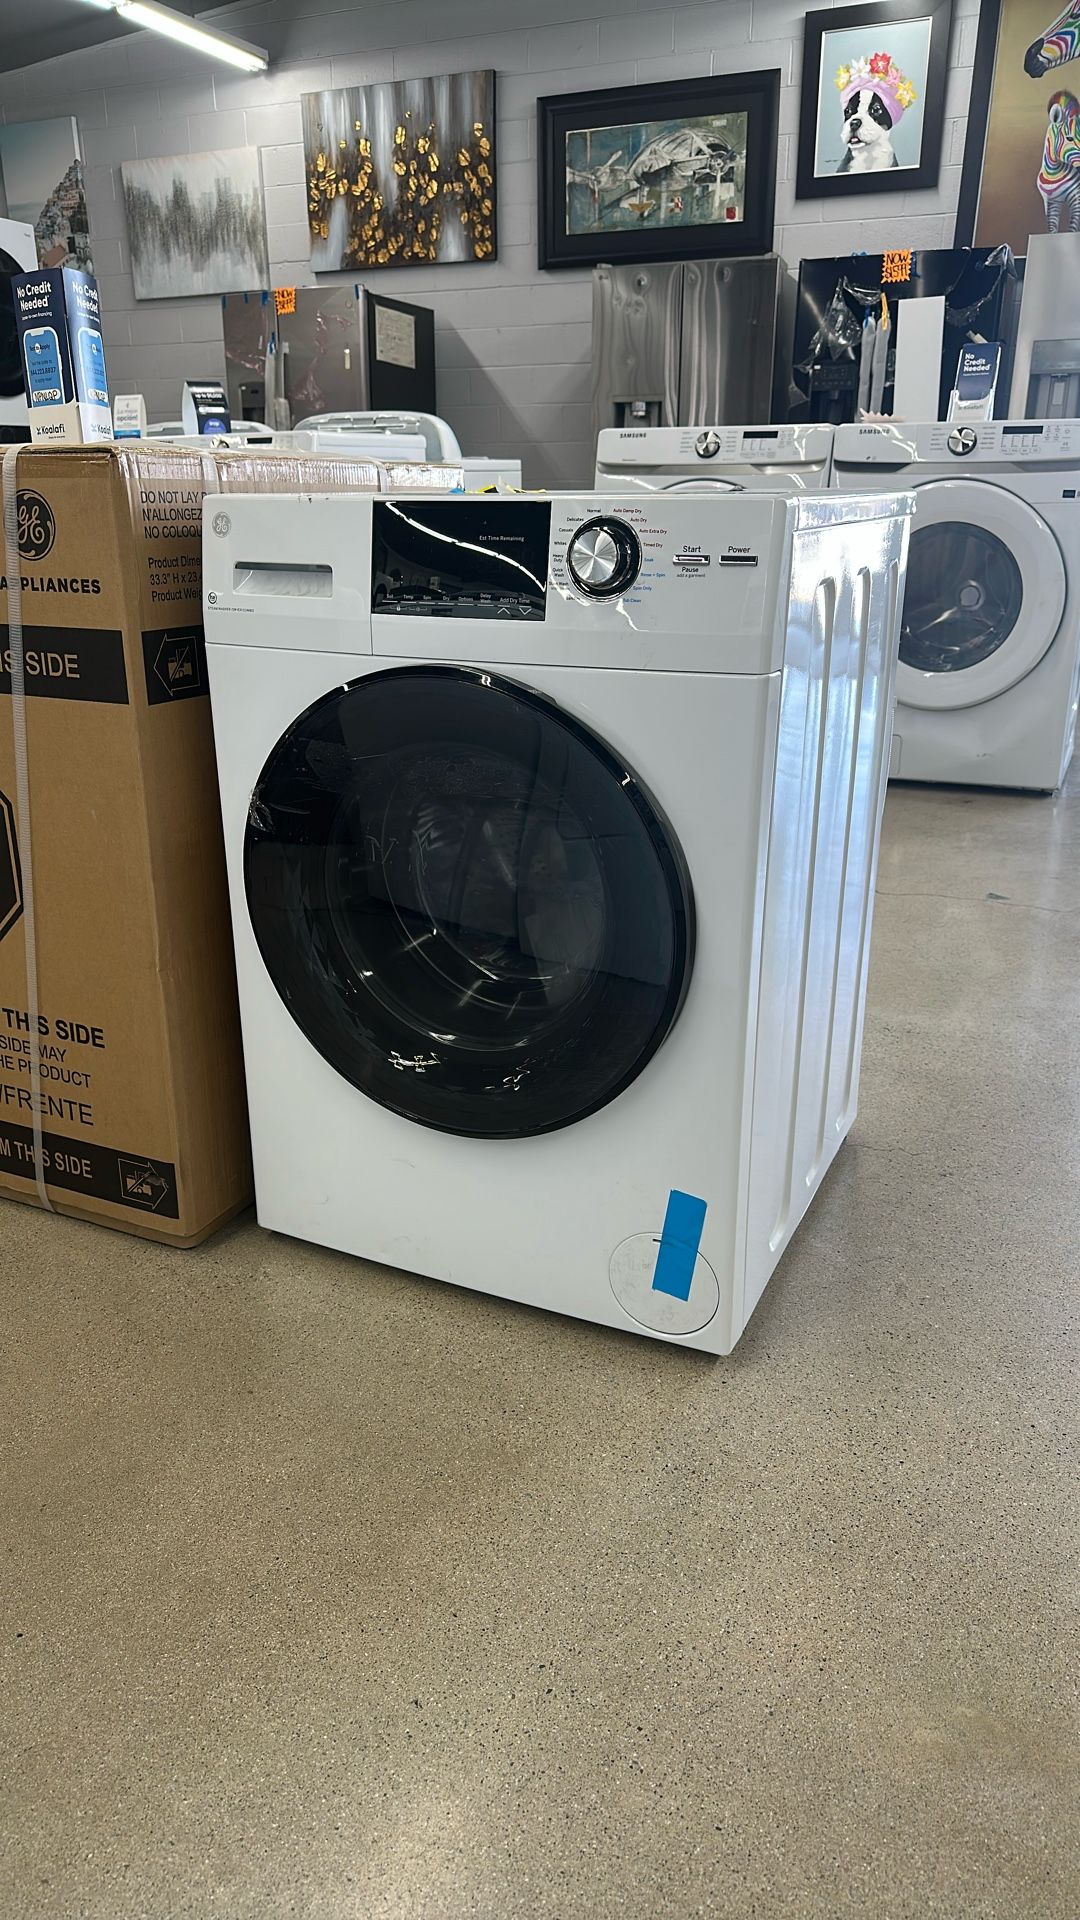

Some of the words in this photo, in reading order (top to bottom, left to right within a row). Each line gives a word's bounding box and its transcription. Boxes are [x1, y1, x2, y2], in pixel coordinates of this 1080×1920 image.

[886, 252, 909, 265] NOW
[17, 286, 26, 298] No
[26, 281, 52, 296] Credit
[72, 281, 83, 295] No
[964, 358, 986, 366] Credit
[41, 424, 65, 434] Koalafi
[140, 491, 156, 503] DO
[158, 491, 178, 503] NOT
[181, 491, 199, 503] LAY
[142, 508, 203, 521] N'ALLONGEZ
[144, 526, 160, 539] NO
[727, 546, 751, 554] Power
[148, 556, 179, 569] Product
[172, 573, 180, 584] H
[181, 575, 187, 583] x
[188, 571, 202, 583] 23.
[0, 575, 101, 594] APLIANCES
[152, 589, 182, 602] Product
[25, 651, 81, 679] SIDE
[2, 1007, 50, 1035] THS
[55, 1019, 105, 1048] SIDE
[39, 1044, 67, 1063] MAY
[18, 1058, 91, 1088] PODUCT
[13, 1140, 51, 1168] THS
[55, 1152, 93, 1179] SIDE
